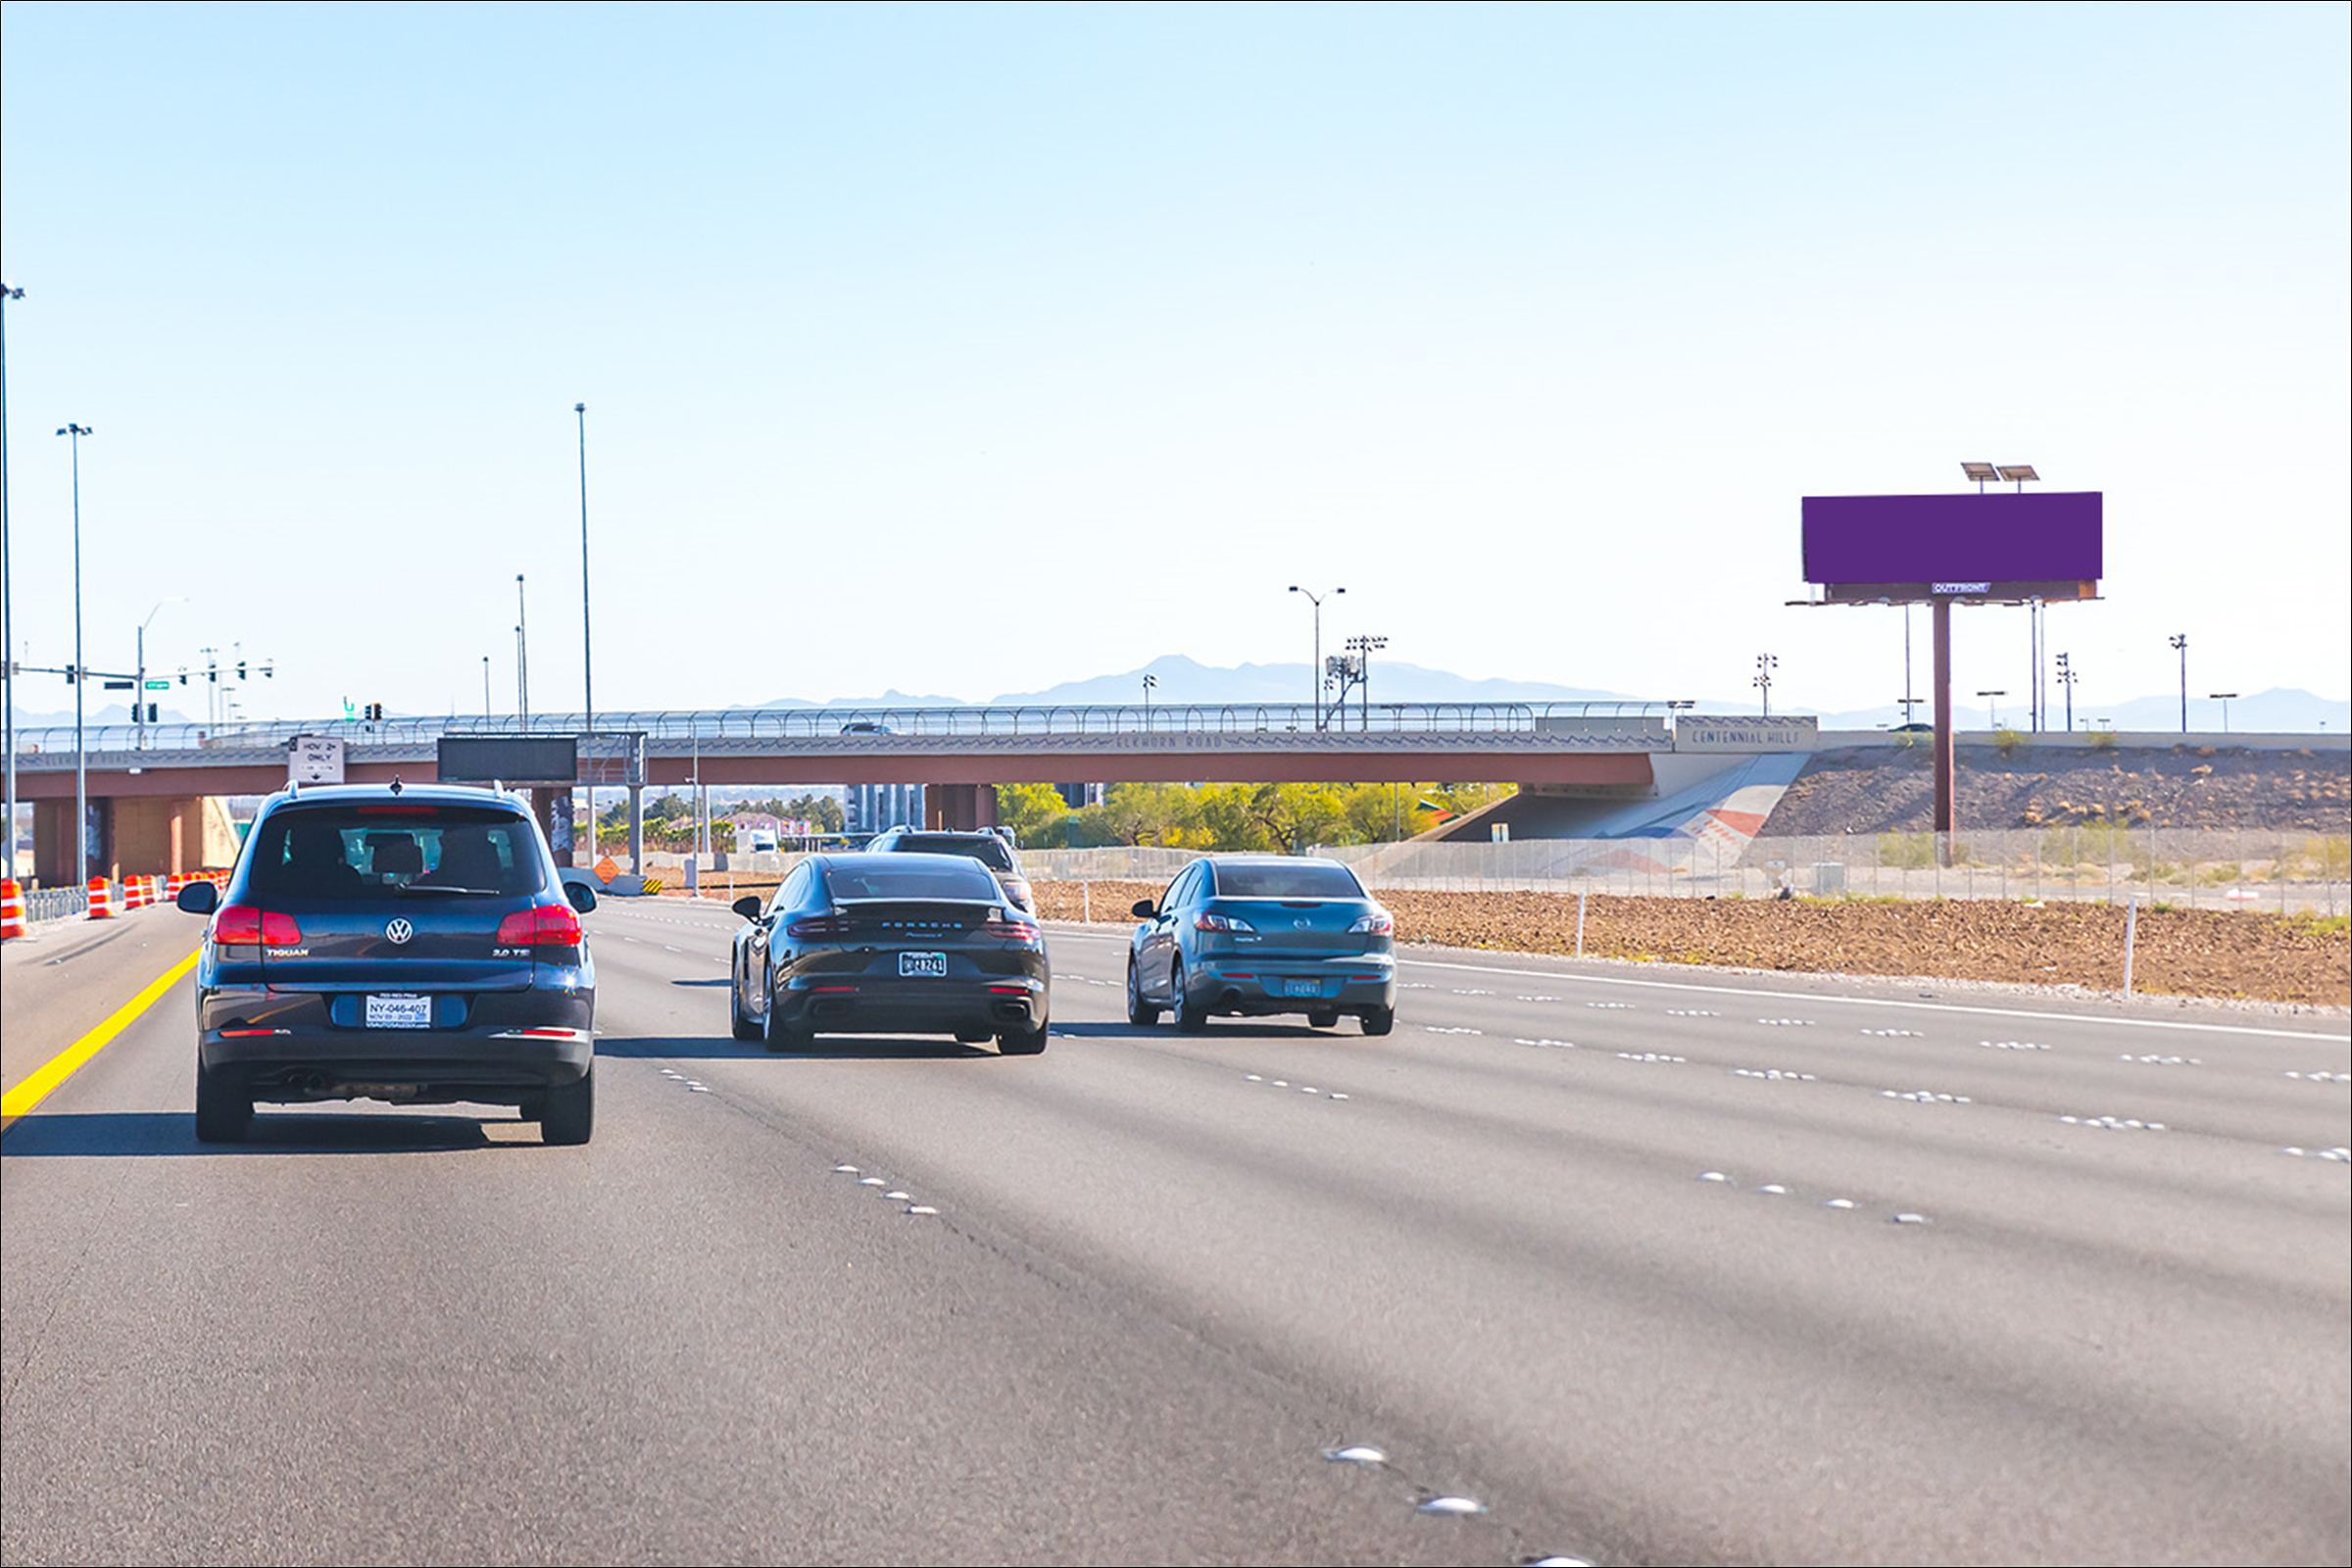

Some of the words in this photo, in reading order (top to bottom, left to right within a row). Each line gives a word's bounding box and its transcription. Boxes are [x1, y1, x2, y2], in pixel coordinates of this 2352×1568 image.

[1934, 582, 1989, 594] OUTFRONT
[1116, 736, 1176, 749] ELKHORN
[1185, 736, 1222, 749] ROAD
[1692, 730, 1763, 744] CENTENNIAL
[1767, 730, 1799, 744] HILLS
[267, 949, 310, 957] TIGUAN
[369, 1004, 427, 1015] NY-046-407
